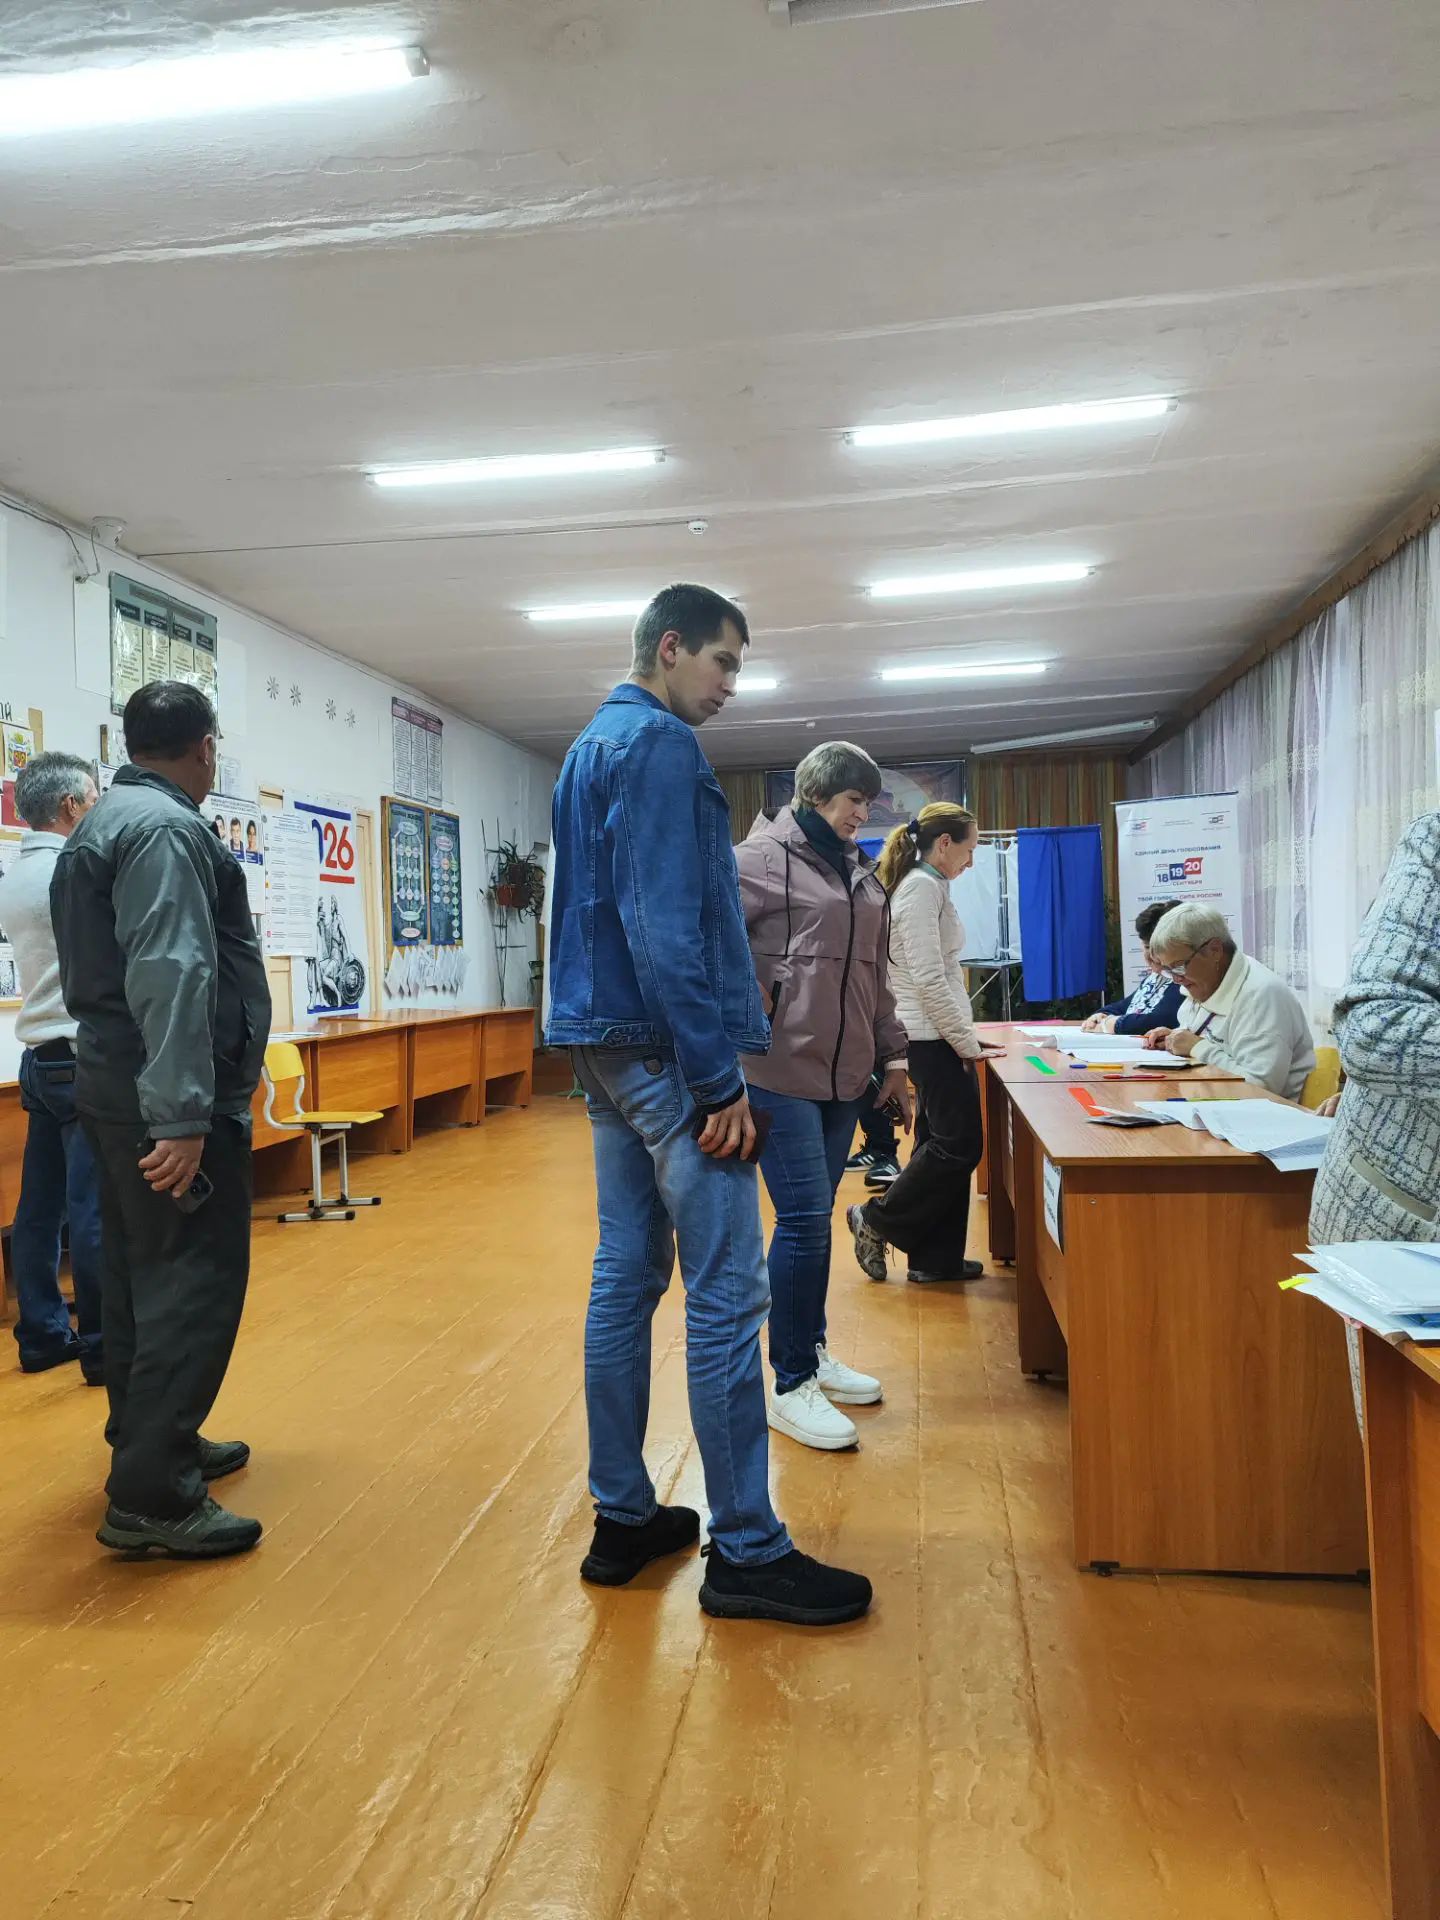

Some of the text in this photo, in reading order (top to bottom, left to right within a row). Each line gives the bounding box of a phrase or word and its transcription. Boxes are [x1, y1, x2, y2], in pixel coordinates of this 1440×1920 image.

[1157, 861, 1200, 883] 18 19 20
